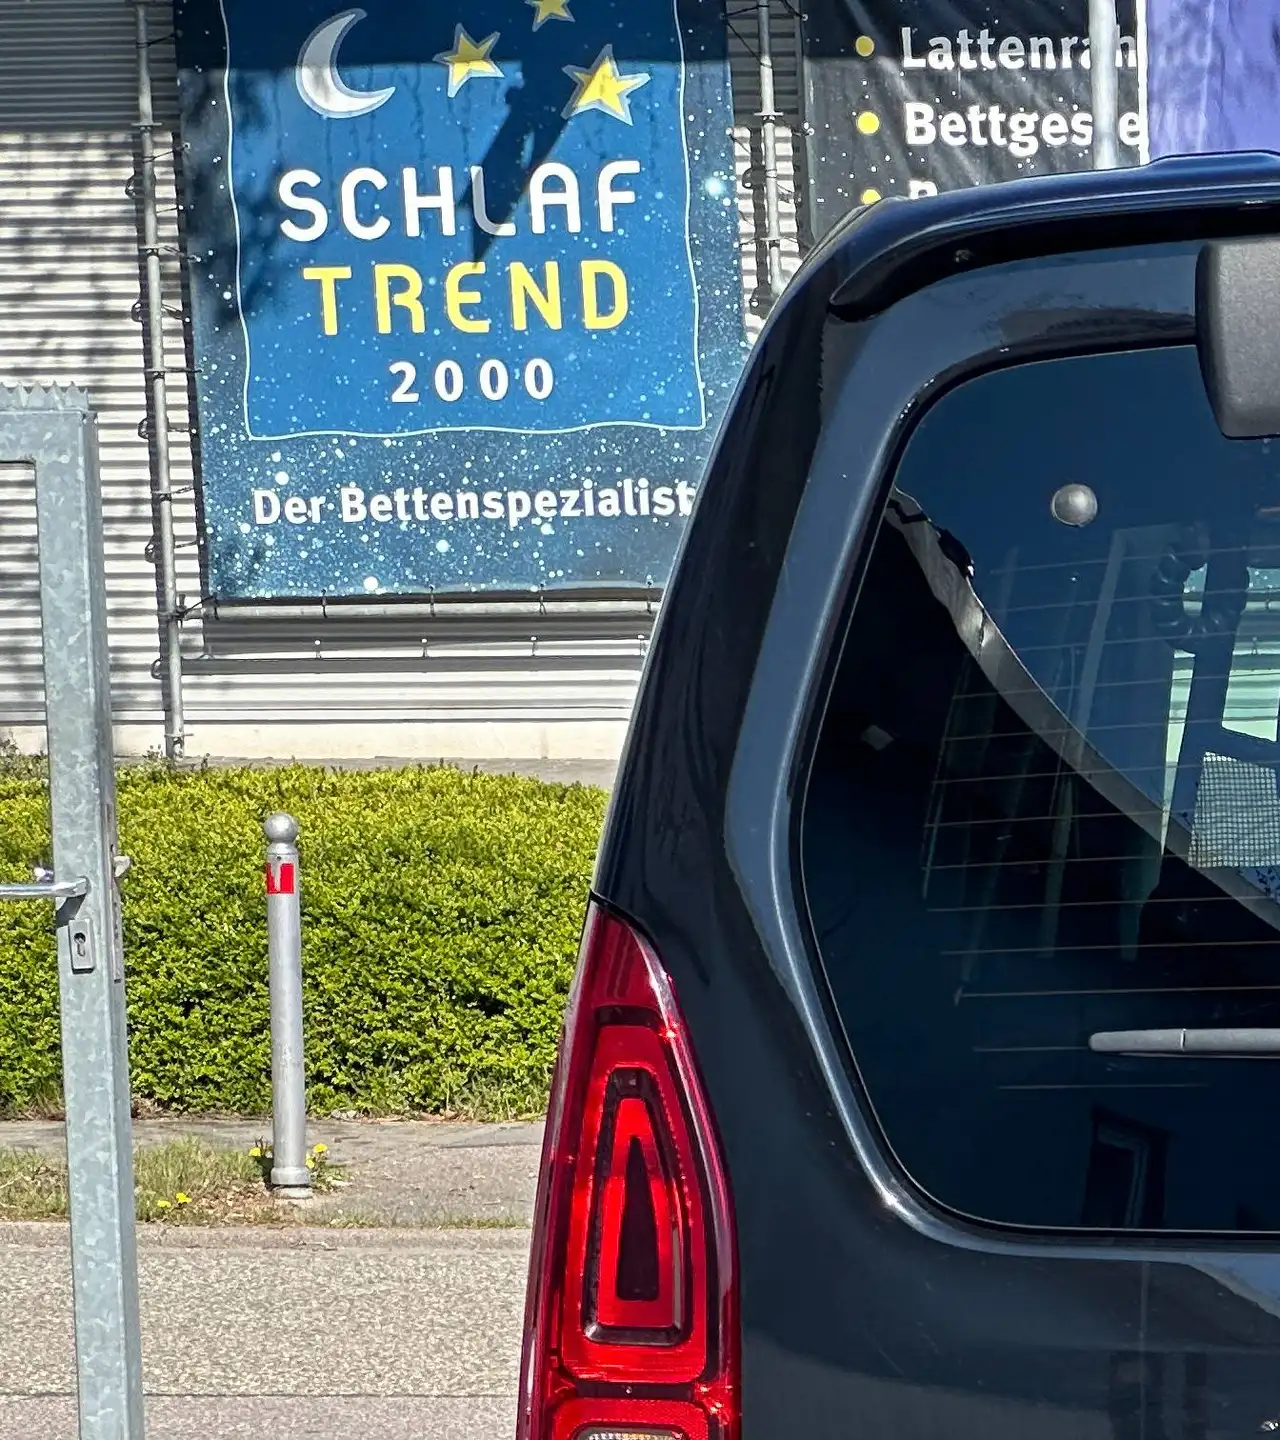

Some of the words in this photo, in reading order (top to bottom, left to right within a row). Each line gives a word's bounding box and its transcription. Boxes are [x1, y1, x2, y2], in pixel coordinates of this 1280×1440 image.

[901, 26, 1138, 70] Lattenrh
[904, 102, 1141, 158] Bettgese
[278, 160, 641, 242] SCHLAF
[302, 260, 629, 336] TREND
[389, 358, 556, 403] 2000
[253, 488, 326, 525] Der
[340, 478, 698, 529] Bettenspezialist
